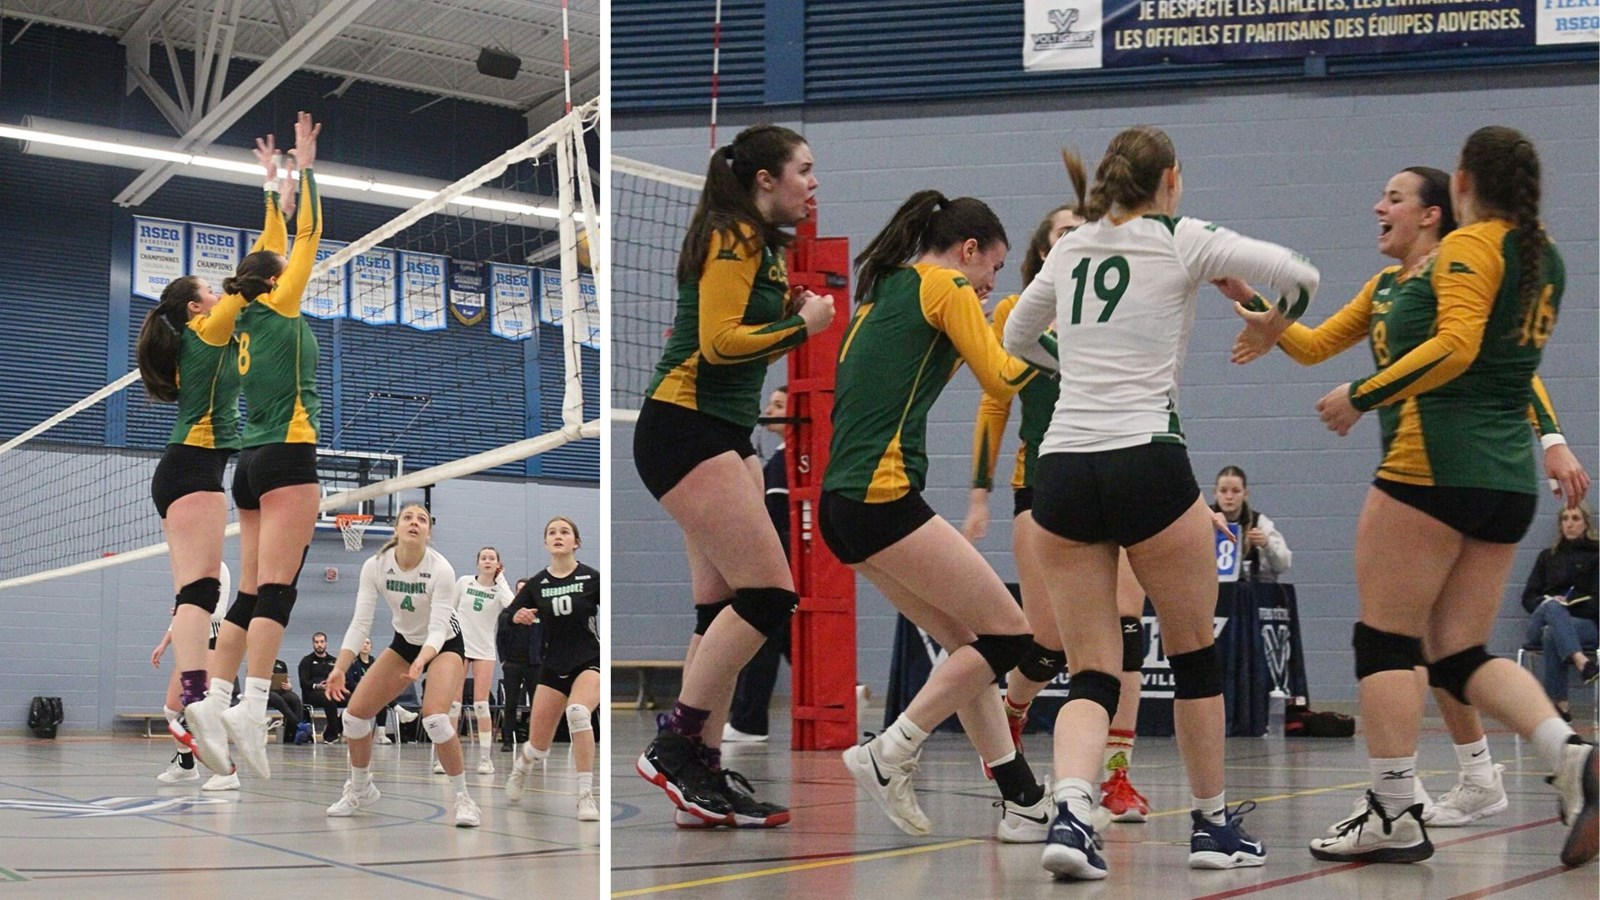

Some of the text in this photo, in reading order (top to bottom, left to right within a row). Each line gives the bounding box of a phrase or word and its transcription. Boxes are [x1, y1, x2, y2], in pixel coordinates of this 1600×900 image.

[1138, 1, 1155, 21] JE
[1158, 0, 1234, 20] RESPECTE
[1238, 0, 1266, 16] LES
[1115, 8, 1525, 49] LES OFFICIELS ET PARTISANS DES ÉQUIPES ADVERSES.
[140, 225, 180, 241] RSEQ
[196, 232, 235, 247] RSEQ
[197, 259, 233, 271] CHAMPIONS
[355, 255, 391, 269] RSEQ
[406, 261, 441, 276] RSEQ
[496, 273, 529, 287] RSEQ
[1071, 255, 1130, 325] 19
[238, 332, 251, 376] 8
[1216, 540, 1235, 570] 8
[400, 595, 416, 612] 4
[473, 597, 485, 612] 5
[551, 595, 573, 617] 10
